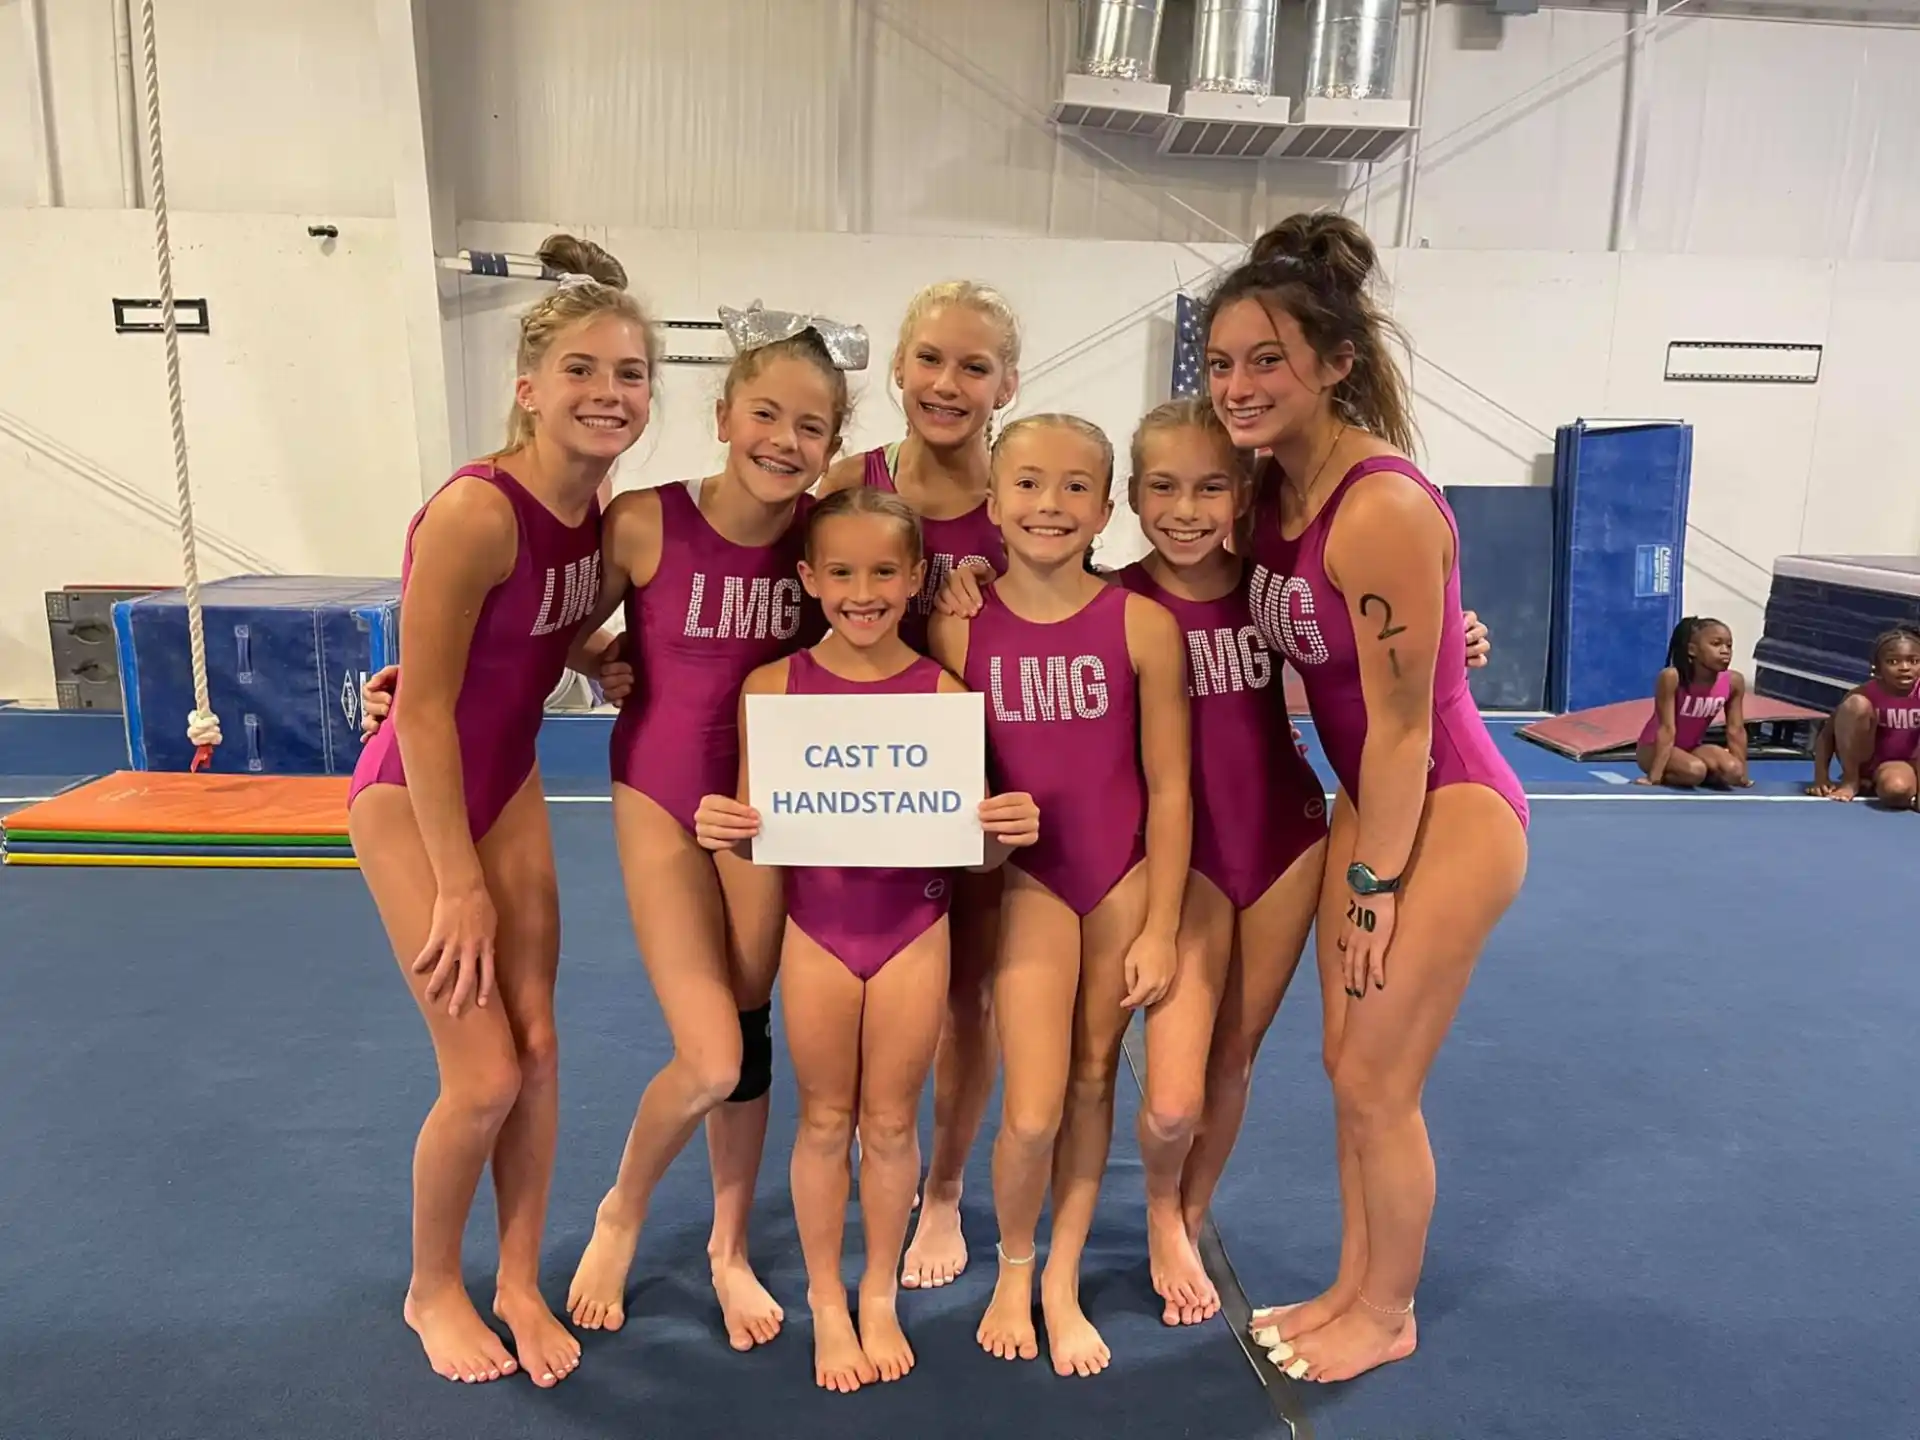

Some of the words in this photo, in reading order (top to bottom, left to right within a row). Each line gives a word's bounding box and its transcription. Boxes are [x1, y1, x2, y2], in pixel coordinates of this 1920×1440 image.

[683, 572, 801, 639] LMG
[990, 655, 1109, 721] LMG
[1187, 625, 1271, 697] MG
[804, 744, 879, 768] CAST
[886, 743, 929, 768] TO
[772, 790, 962, 814] HANDSTAND
